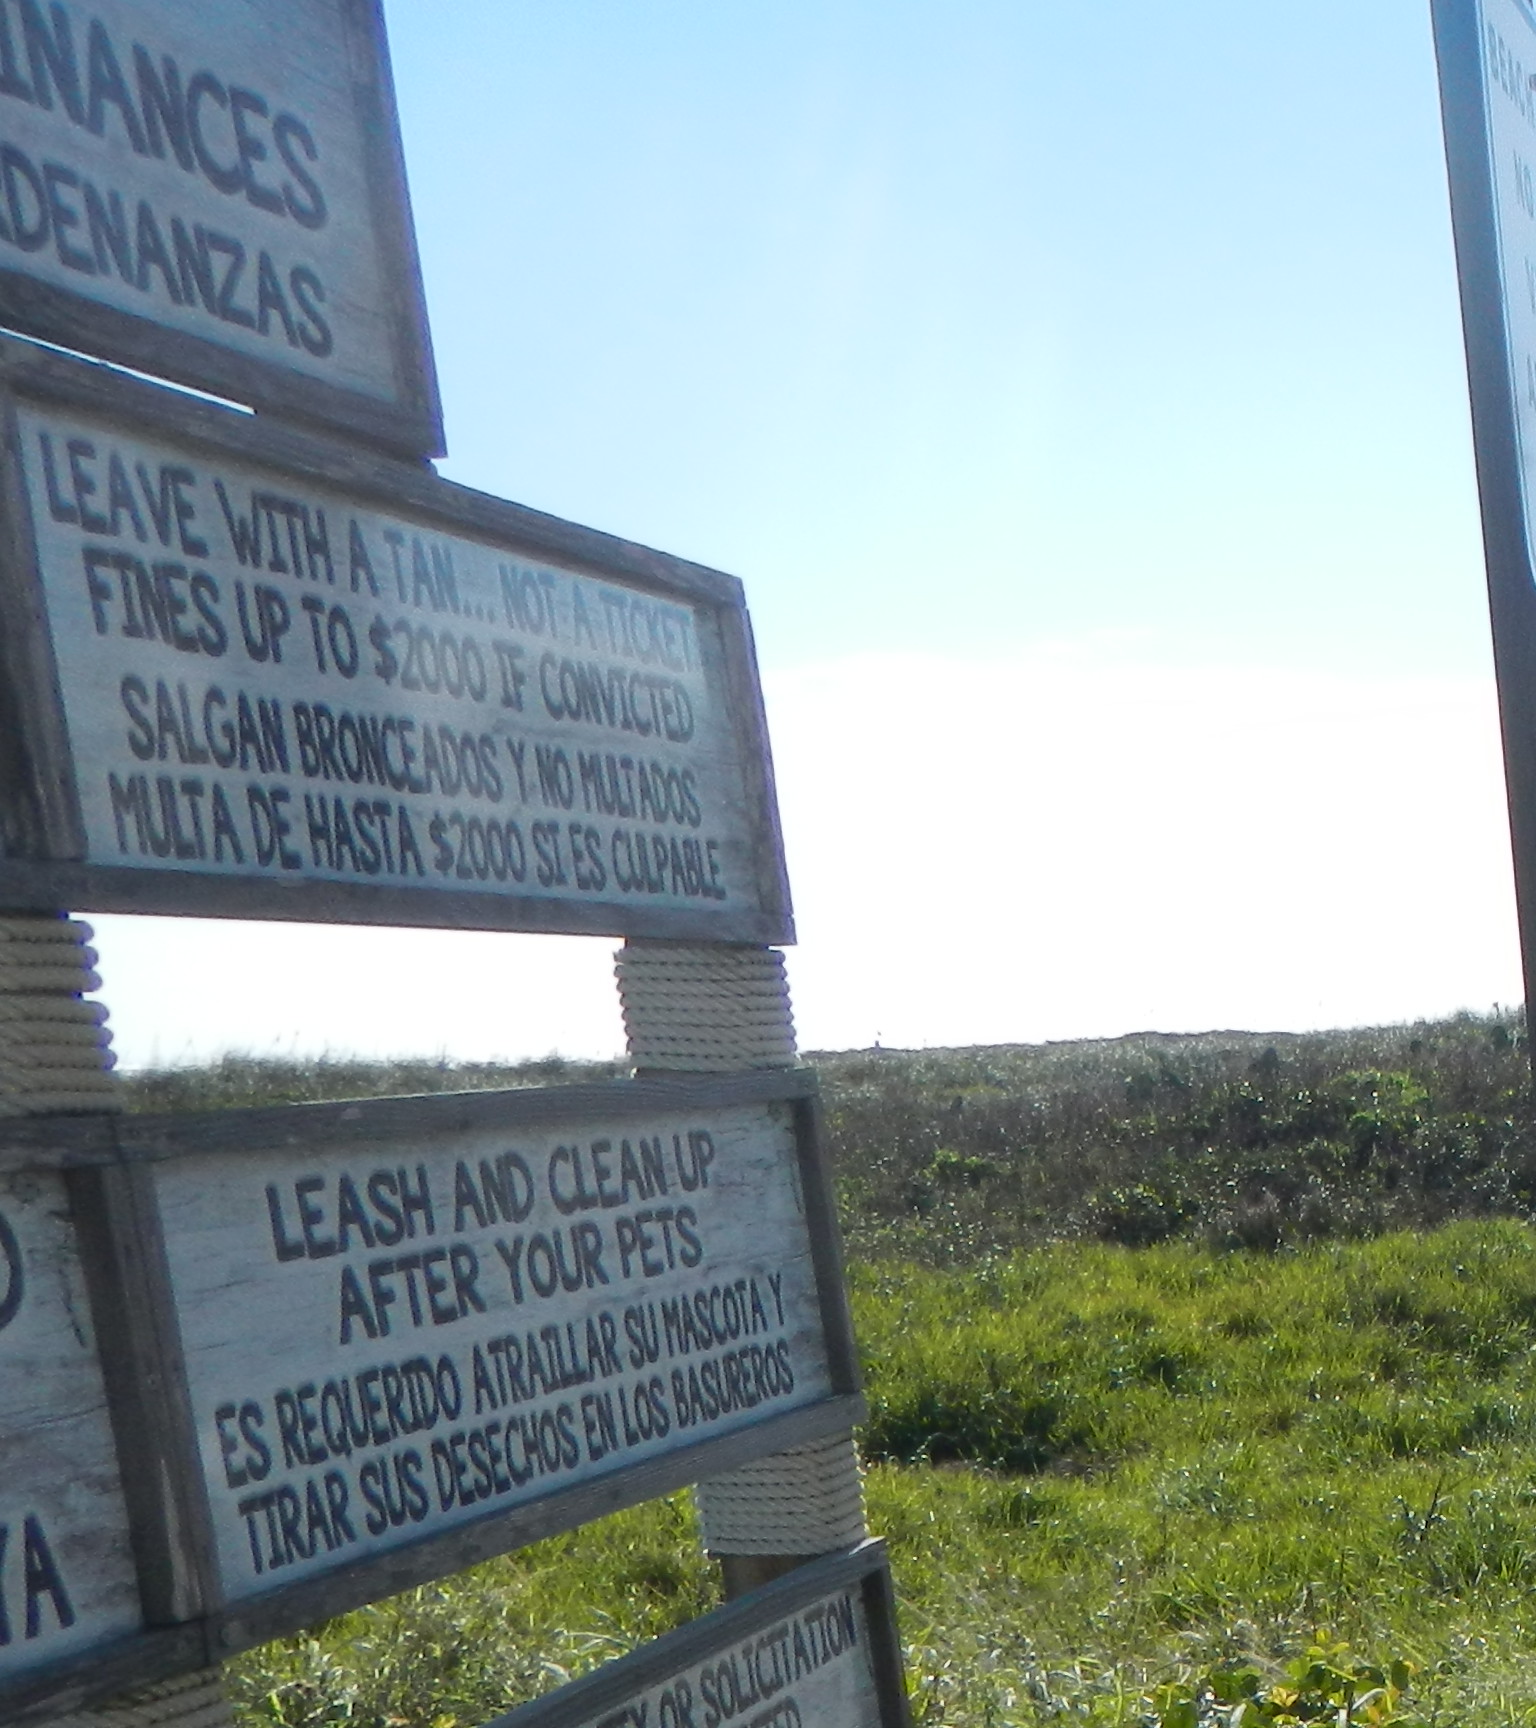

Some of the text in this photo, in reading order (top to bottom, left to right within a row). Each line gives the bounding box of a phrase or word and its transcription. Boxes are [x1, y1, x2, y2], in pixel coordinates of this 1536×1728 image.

[1487, 21, 1535, 122] BEACH
[0, 142, 333, 358] DENANZAS
[1512, 148, 1534, 221] NO
[40, 432, 208, 560] LEAVE
[214, 480, 335, 583] WITH
[349, 518, 380, 598] A
[500, 563, 561, 635] NOT
[573, 581, 597, 650] A
[600, 591, 698, 673] TICKET
[83, 546, 696, 743] FINES UP TO $2000 IF CONVICTED
[120, 677, 702, 829] SALGAN BRONCEADOS Y NO MULTADOS
[109, 773, 726, 901] MULTA DE HASTA $2000 SI ES CULPABLE
[266, 1129, 716, 1263] LEASH AND CLEAN UP
[340, 1206, 704, 1345] AFTER YOUR PETS
[214, 1273, 786, 1489] ES REQUERIDO ATRAILLAR SU MASCOTA Y
[239, 1342, 796, 1576] TIRAR SUS DESECHOS EN LOS BASUREROS
[700, 1595, 858, 1719] SOLICITATION
